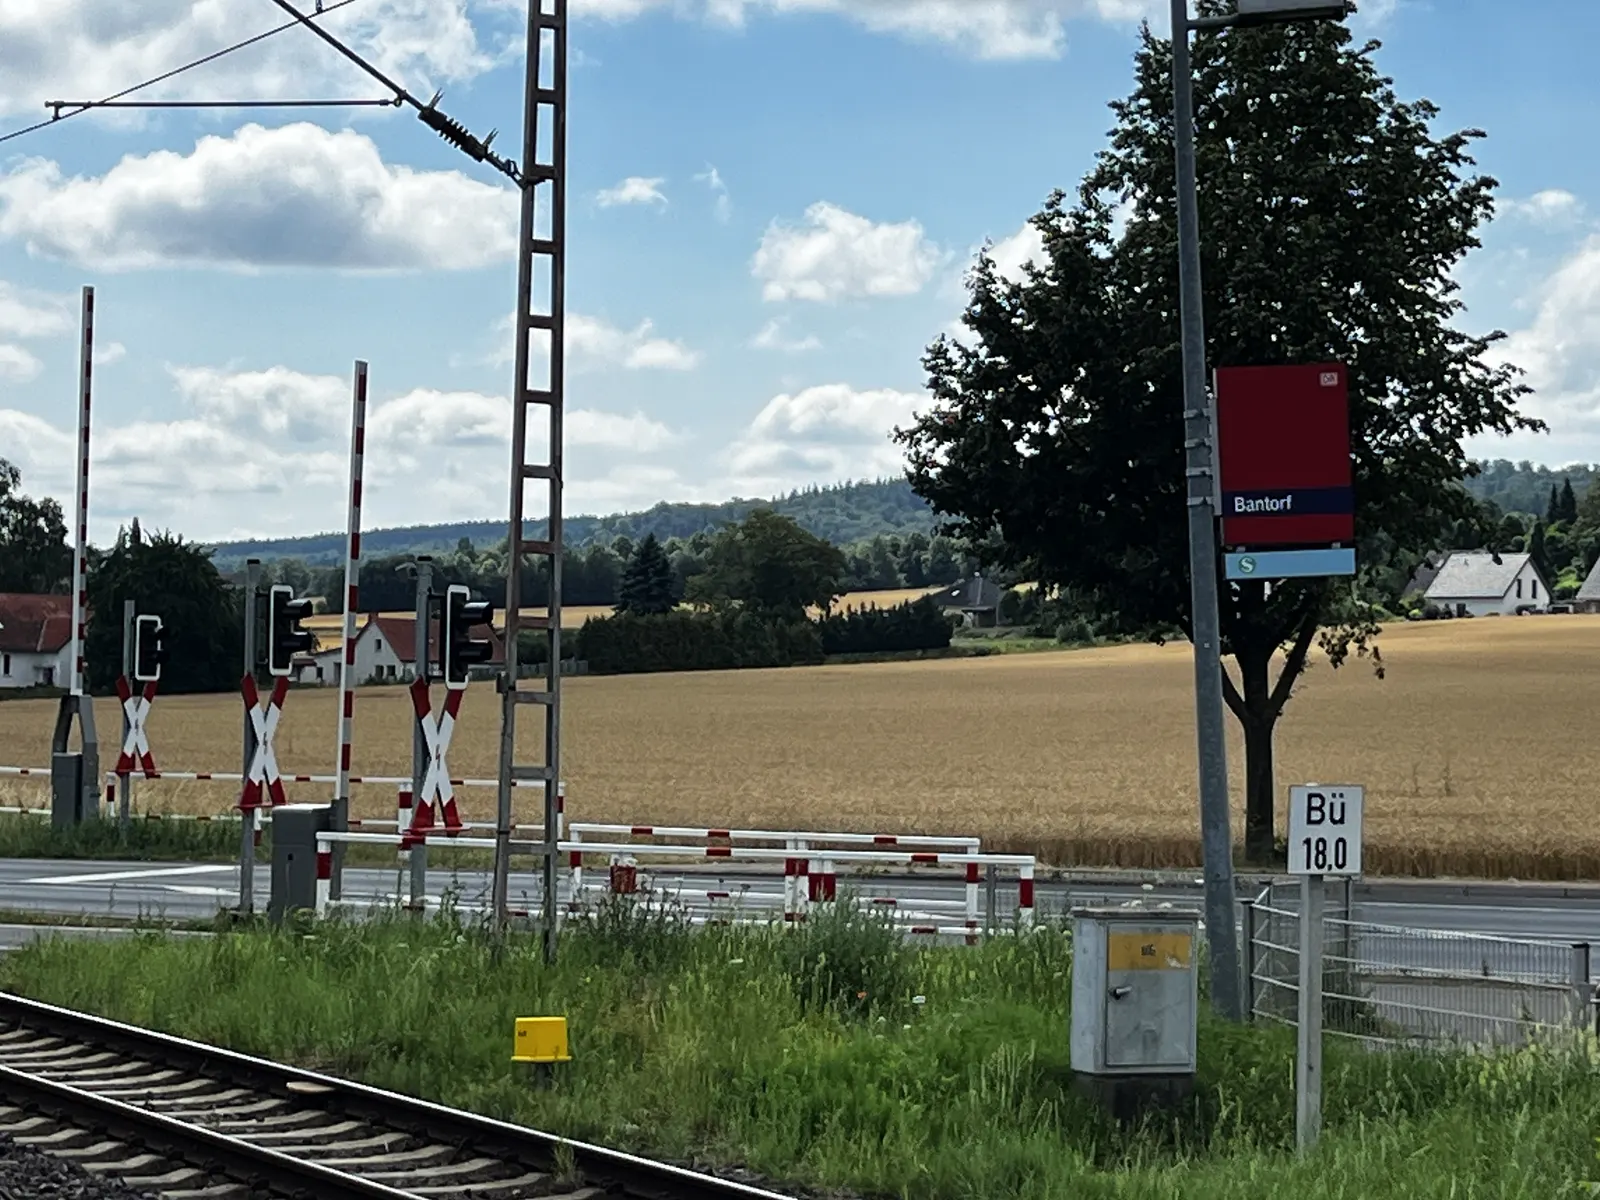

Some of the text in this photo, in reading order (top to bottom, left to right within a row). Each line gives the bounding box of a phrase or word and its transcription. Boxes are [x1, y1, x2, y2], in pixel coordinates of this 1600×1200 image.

[1234, 495, 1292, 512] Bantorf
[1240, 557, 1254, 573] S
[1306, 792, 1345, 825] Bü
